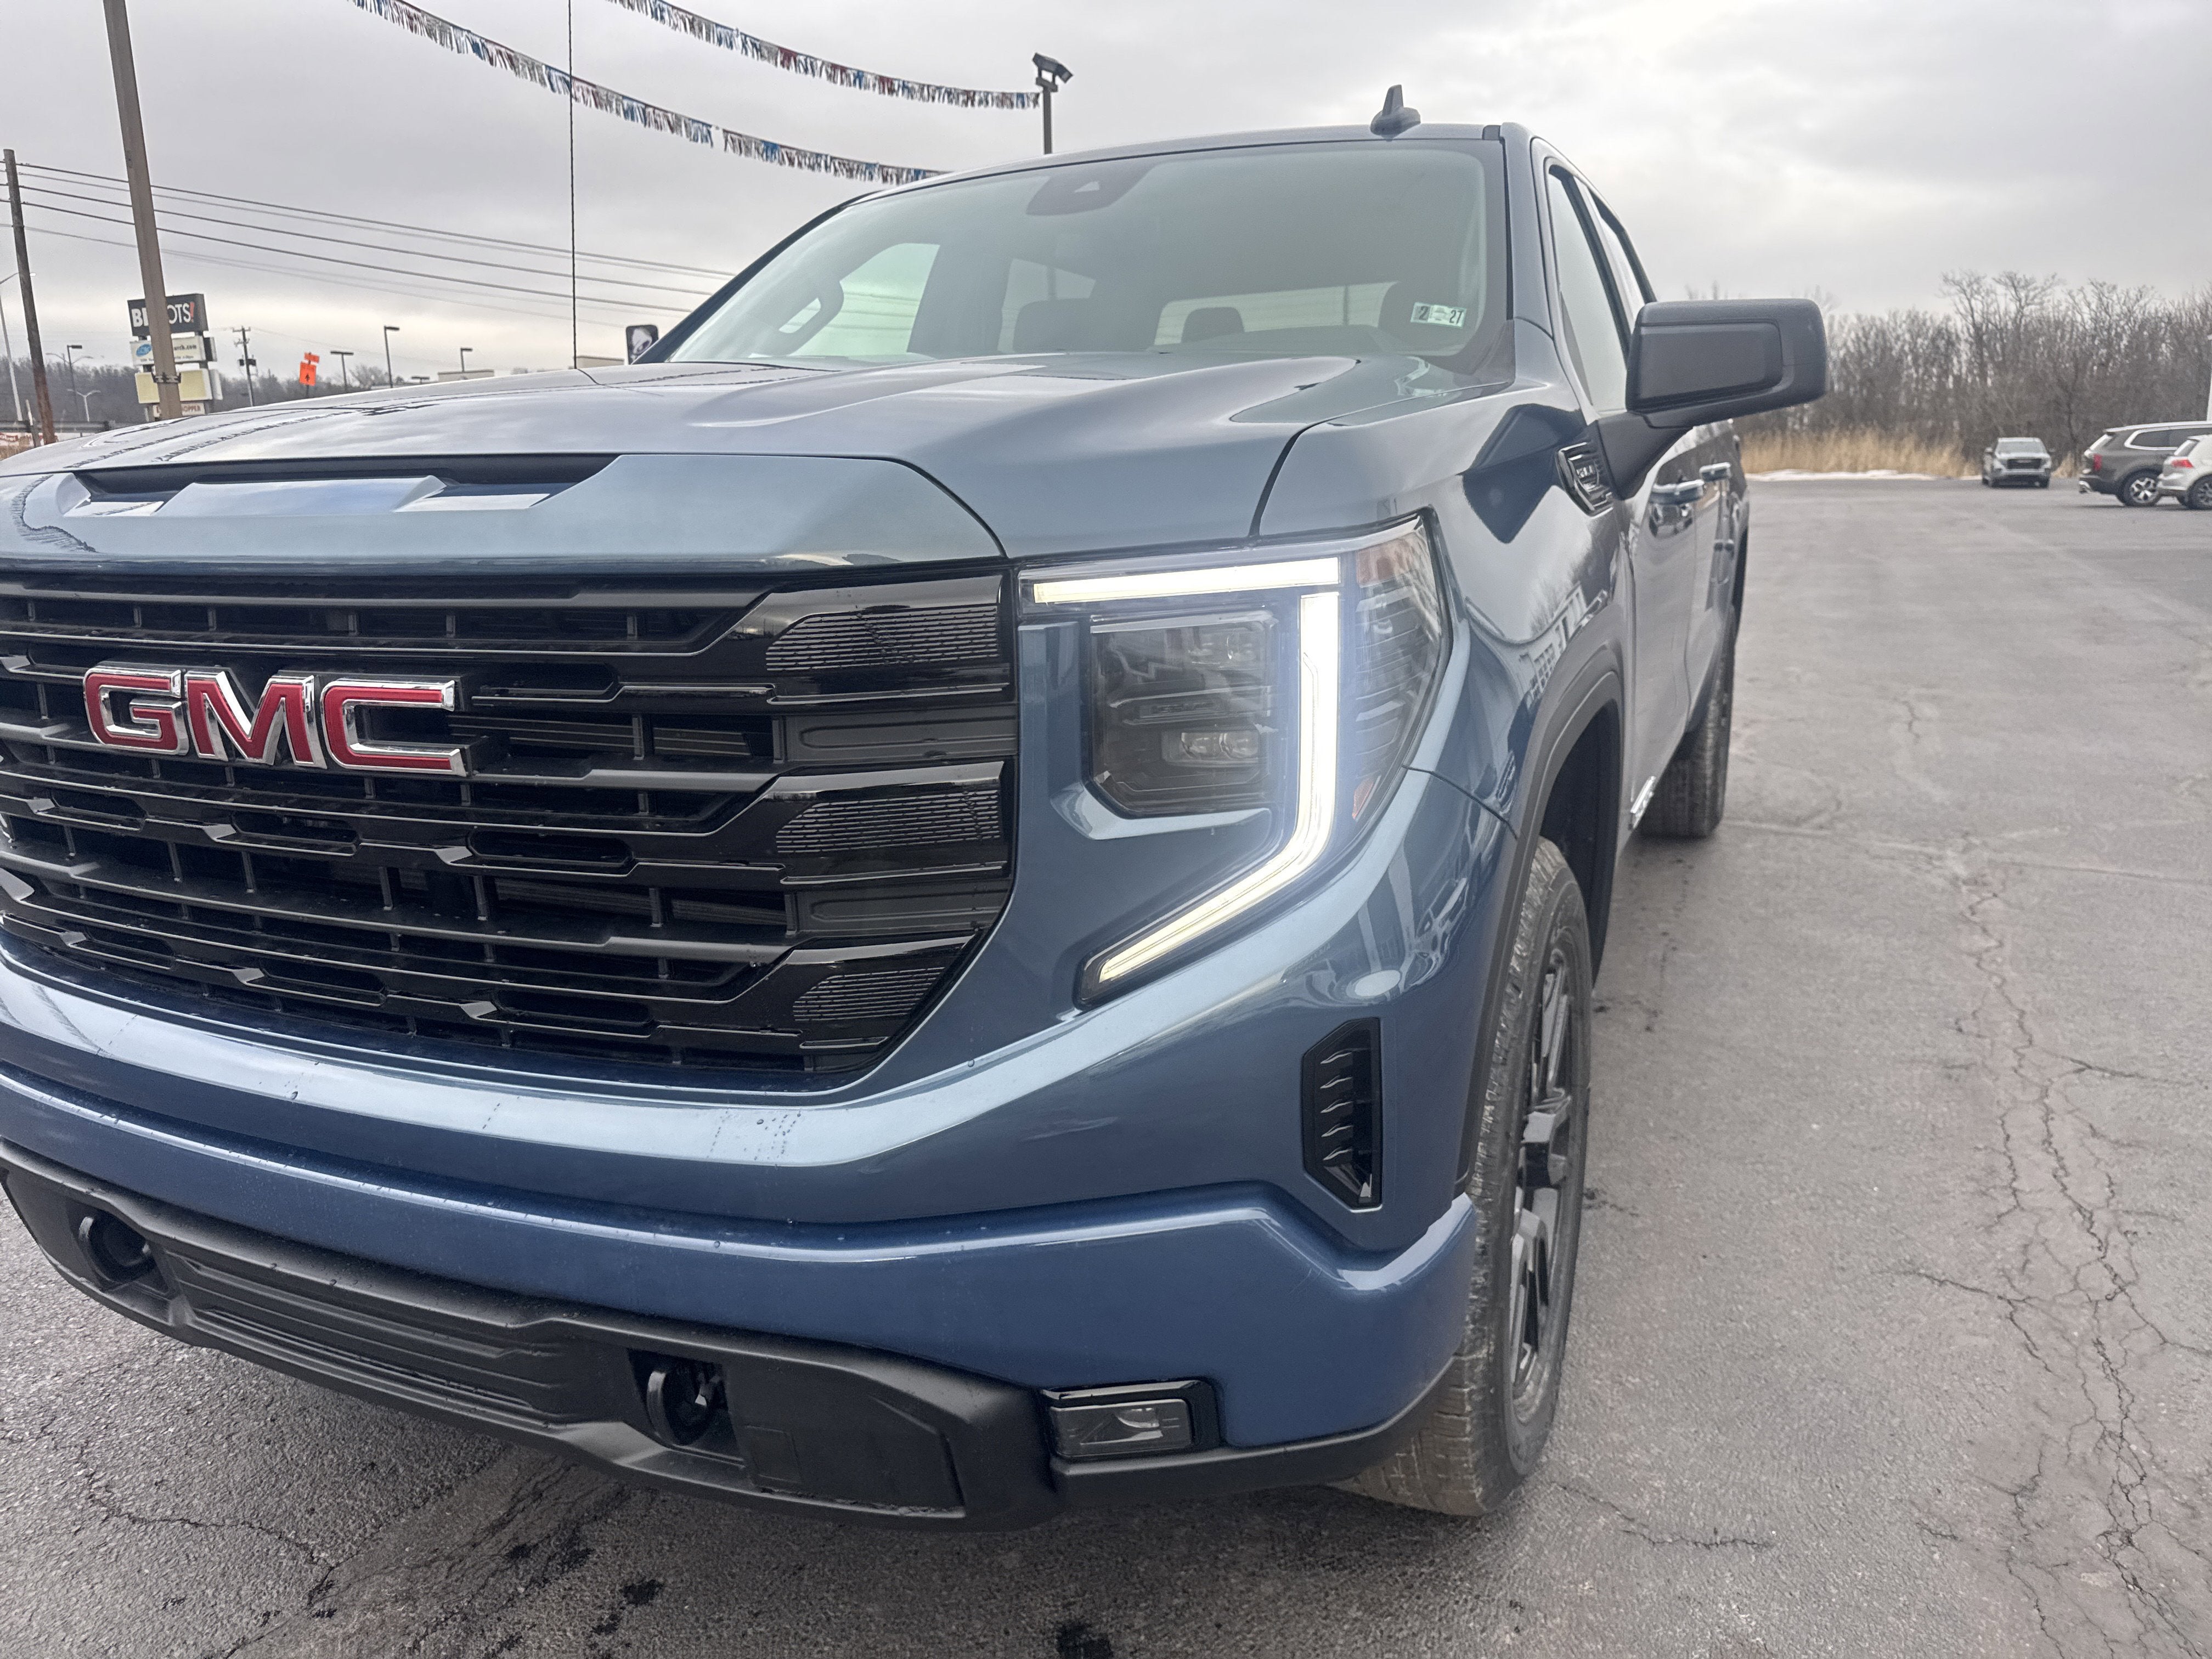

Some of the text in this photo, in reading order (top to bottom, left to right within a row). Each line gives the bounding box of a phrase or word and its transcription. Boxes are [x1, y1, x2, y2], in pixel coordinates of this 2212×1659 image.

[131, 302, 195, 328] BI OTS!
[1419, 306, 1464, 325] 2 27
[83, 667, 466, 777] GMC
